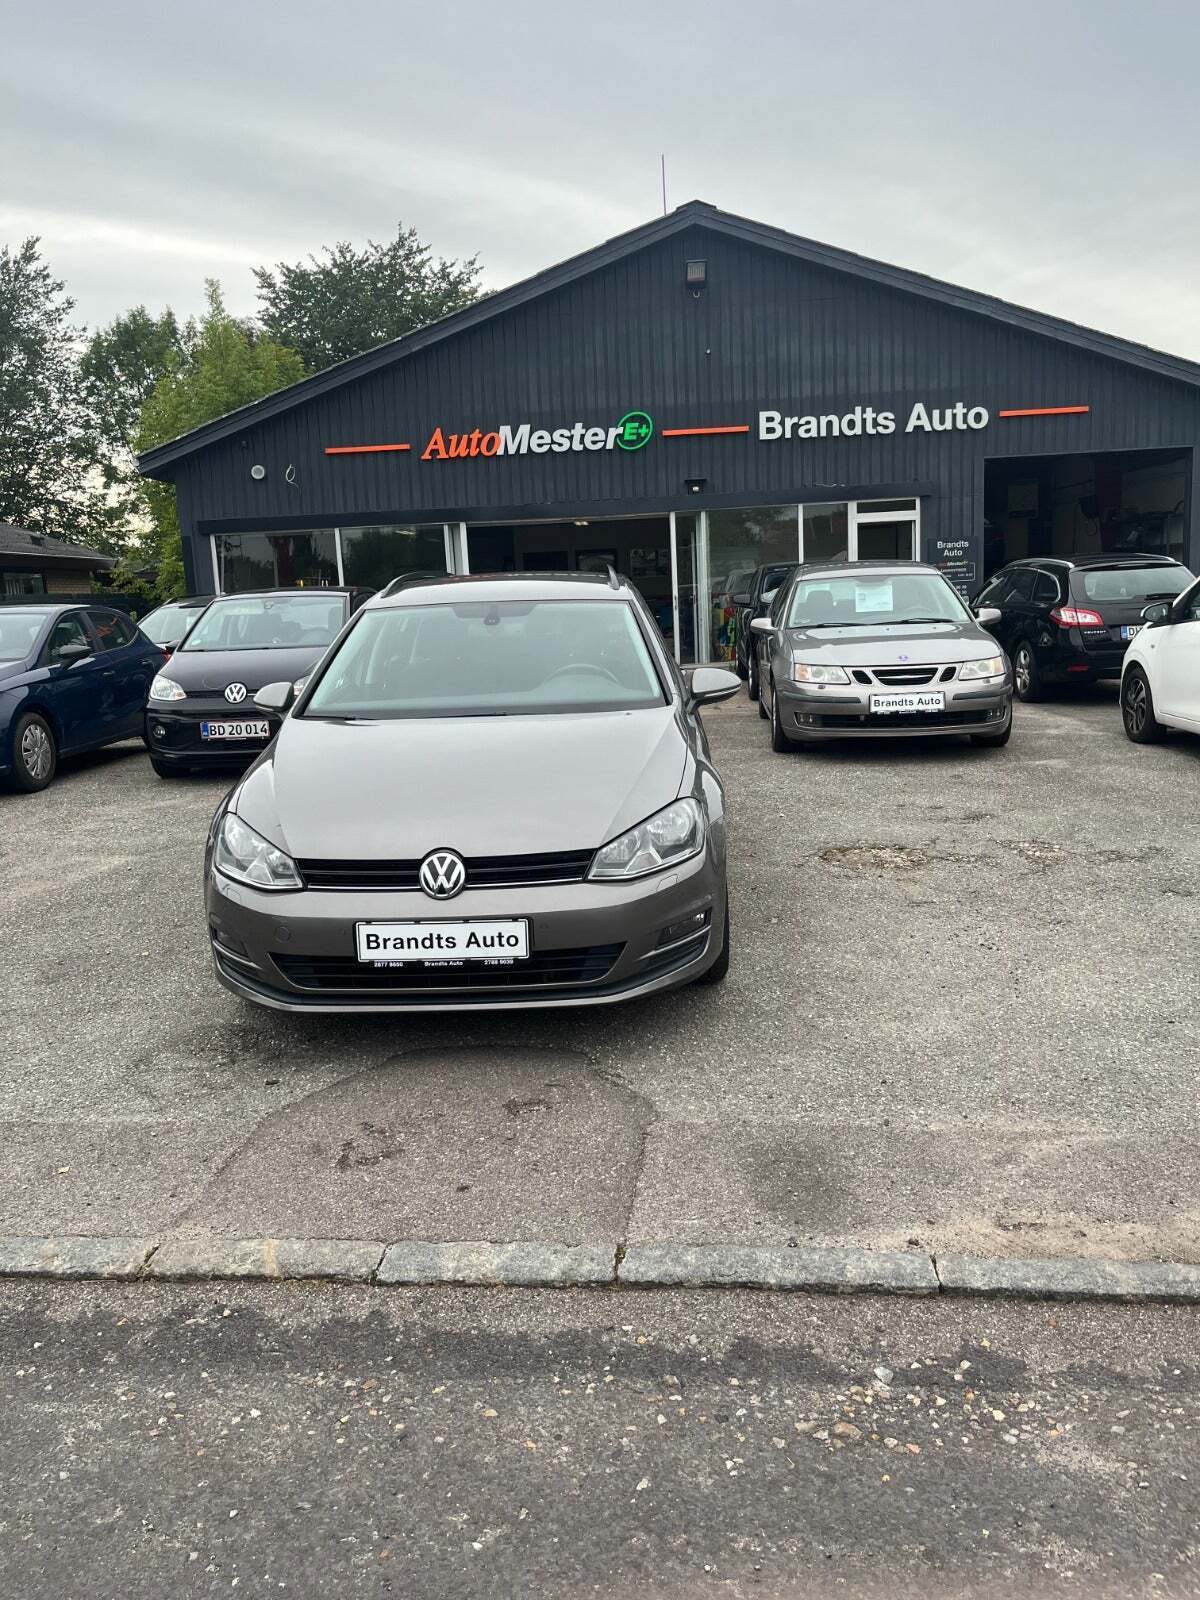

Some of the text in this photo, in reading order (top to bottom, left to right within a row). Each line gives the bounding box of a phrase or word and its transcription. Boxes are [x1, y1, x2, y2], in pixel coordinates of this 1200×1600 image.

[759, 402, 989, 440] Brandts Auto
[421, 423, 623, 459] AutoMester
[937, 540, 969, 549] Brandts
[943, 549, 963, 557] Auto
[874, 697, 941, 707] Brandts Auto
[209, 723, 268, 736] BD 20 014
[366, 931, 519, 949] Brandts Auto
